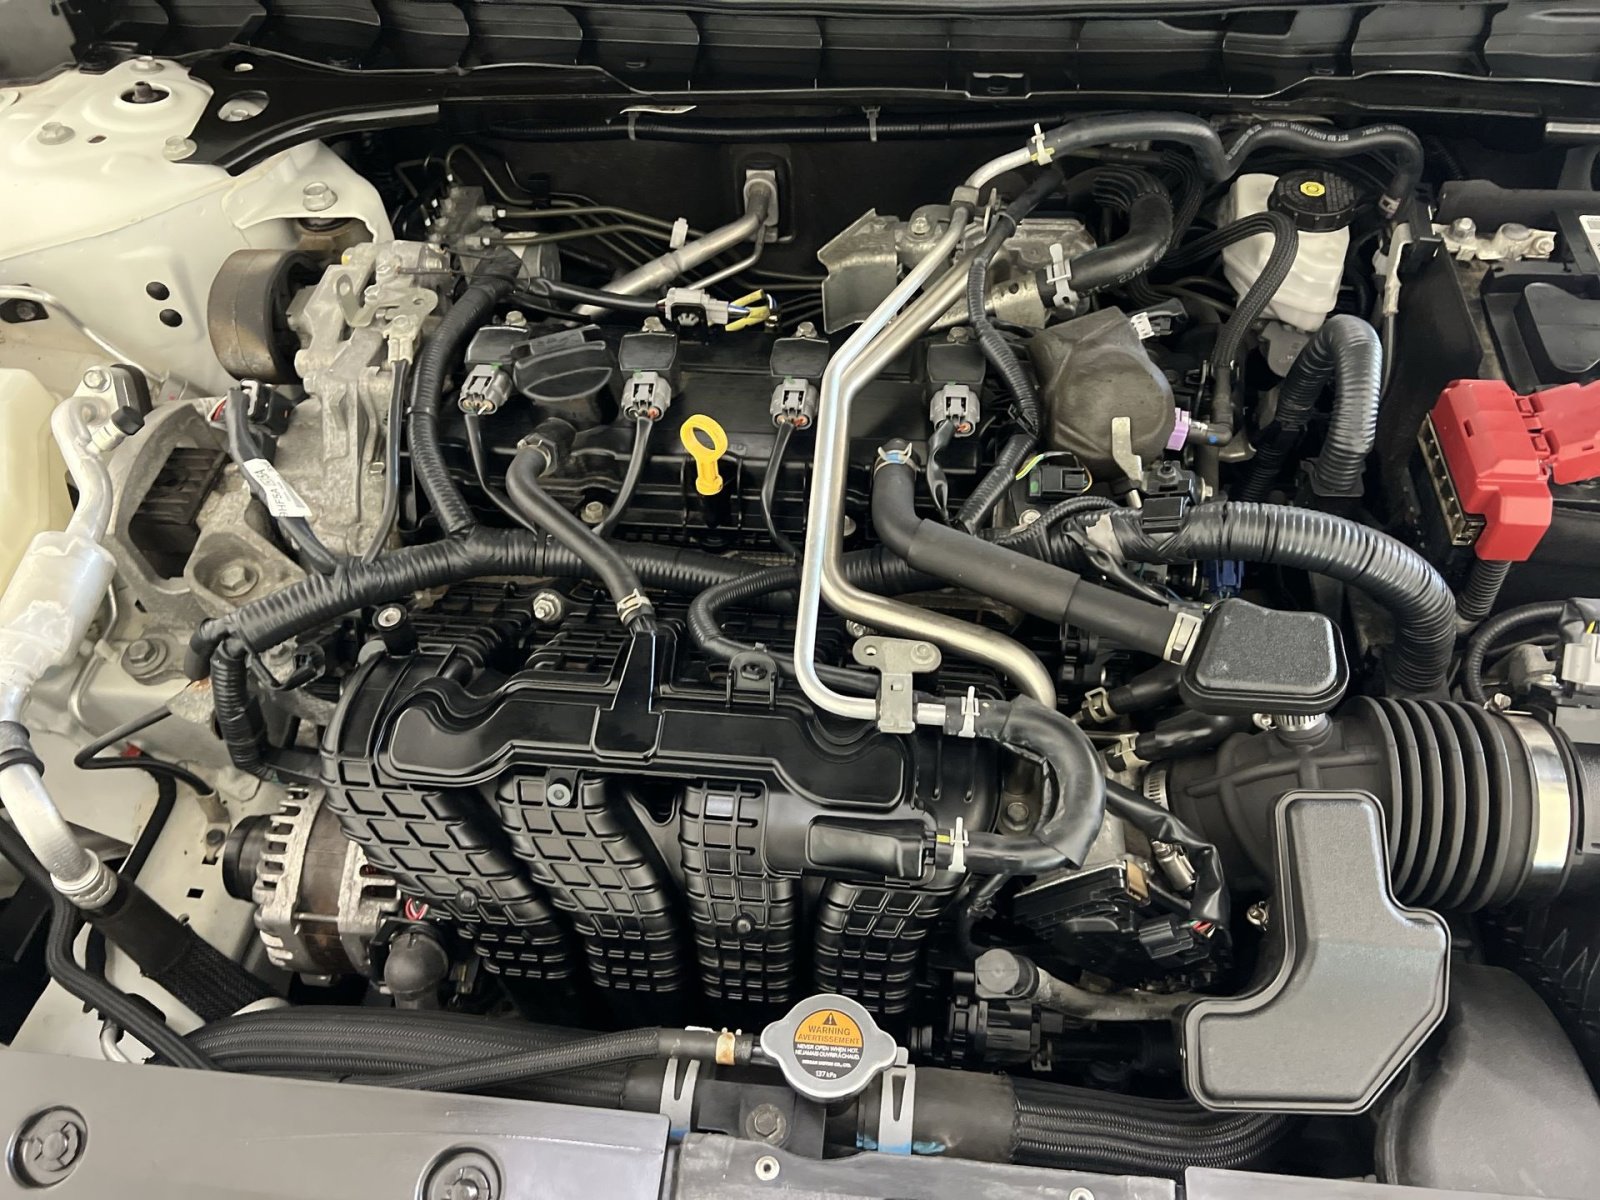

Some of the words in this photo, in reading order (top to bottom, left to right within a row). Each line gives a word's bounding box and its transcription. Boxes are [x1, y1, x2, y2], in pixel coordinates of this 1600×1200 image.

[808, 1025, 850, 1035] WARNING
[798, 1034, 859, 1044] AVERTISSEMENT
[826, 1070, 837, 1079] kPa
